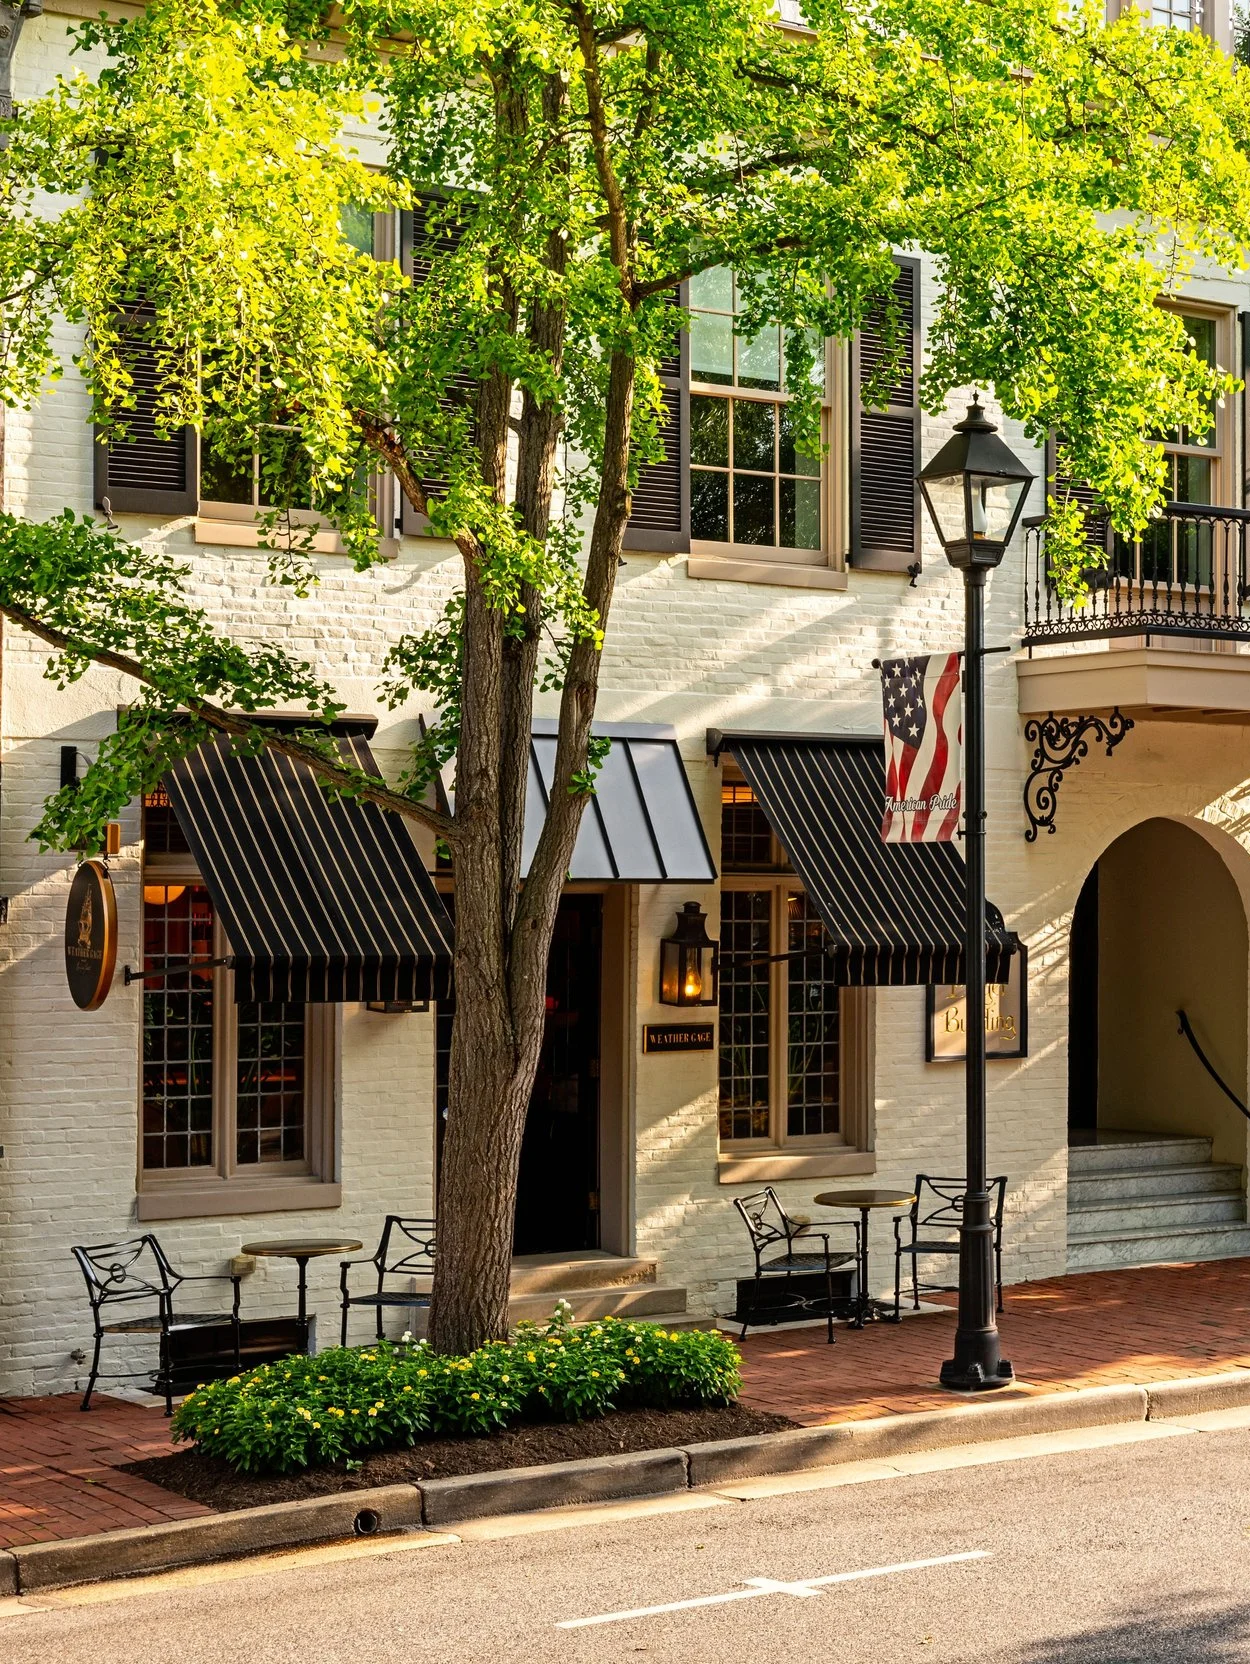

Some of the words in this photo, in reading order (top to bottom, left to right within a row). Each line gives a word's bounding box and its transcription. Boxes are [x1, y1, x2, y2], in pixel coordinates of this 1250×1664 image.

[885, 796, 927, 812] American
[929, 793, 957, 811] Pride
[650, 1033, 689, 1044] WEATHER
[690, 1032, 711, 1042] GAGE
